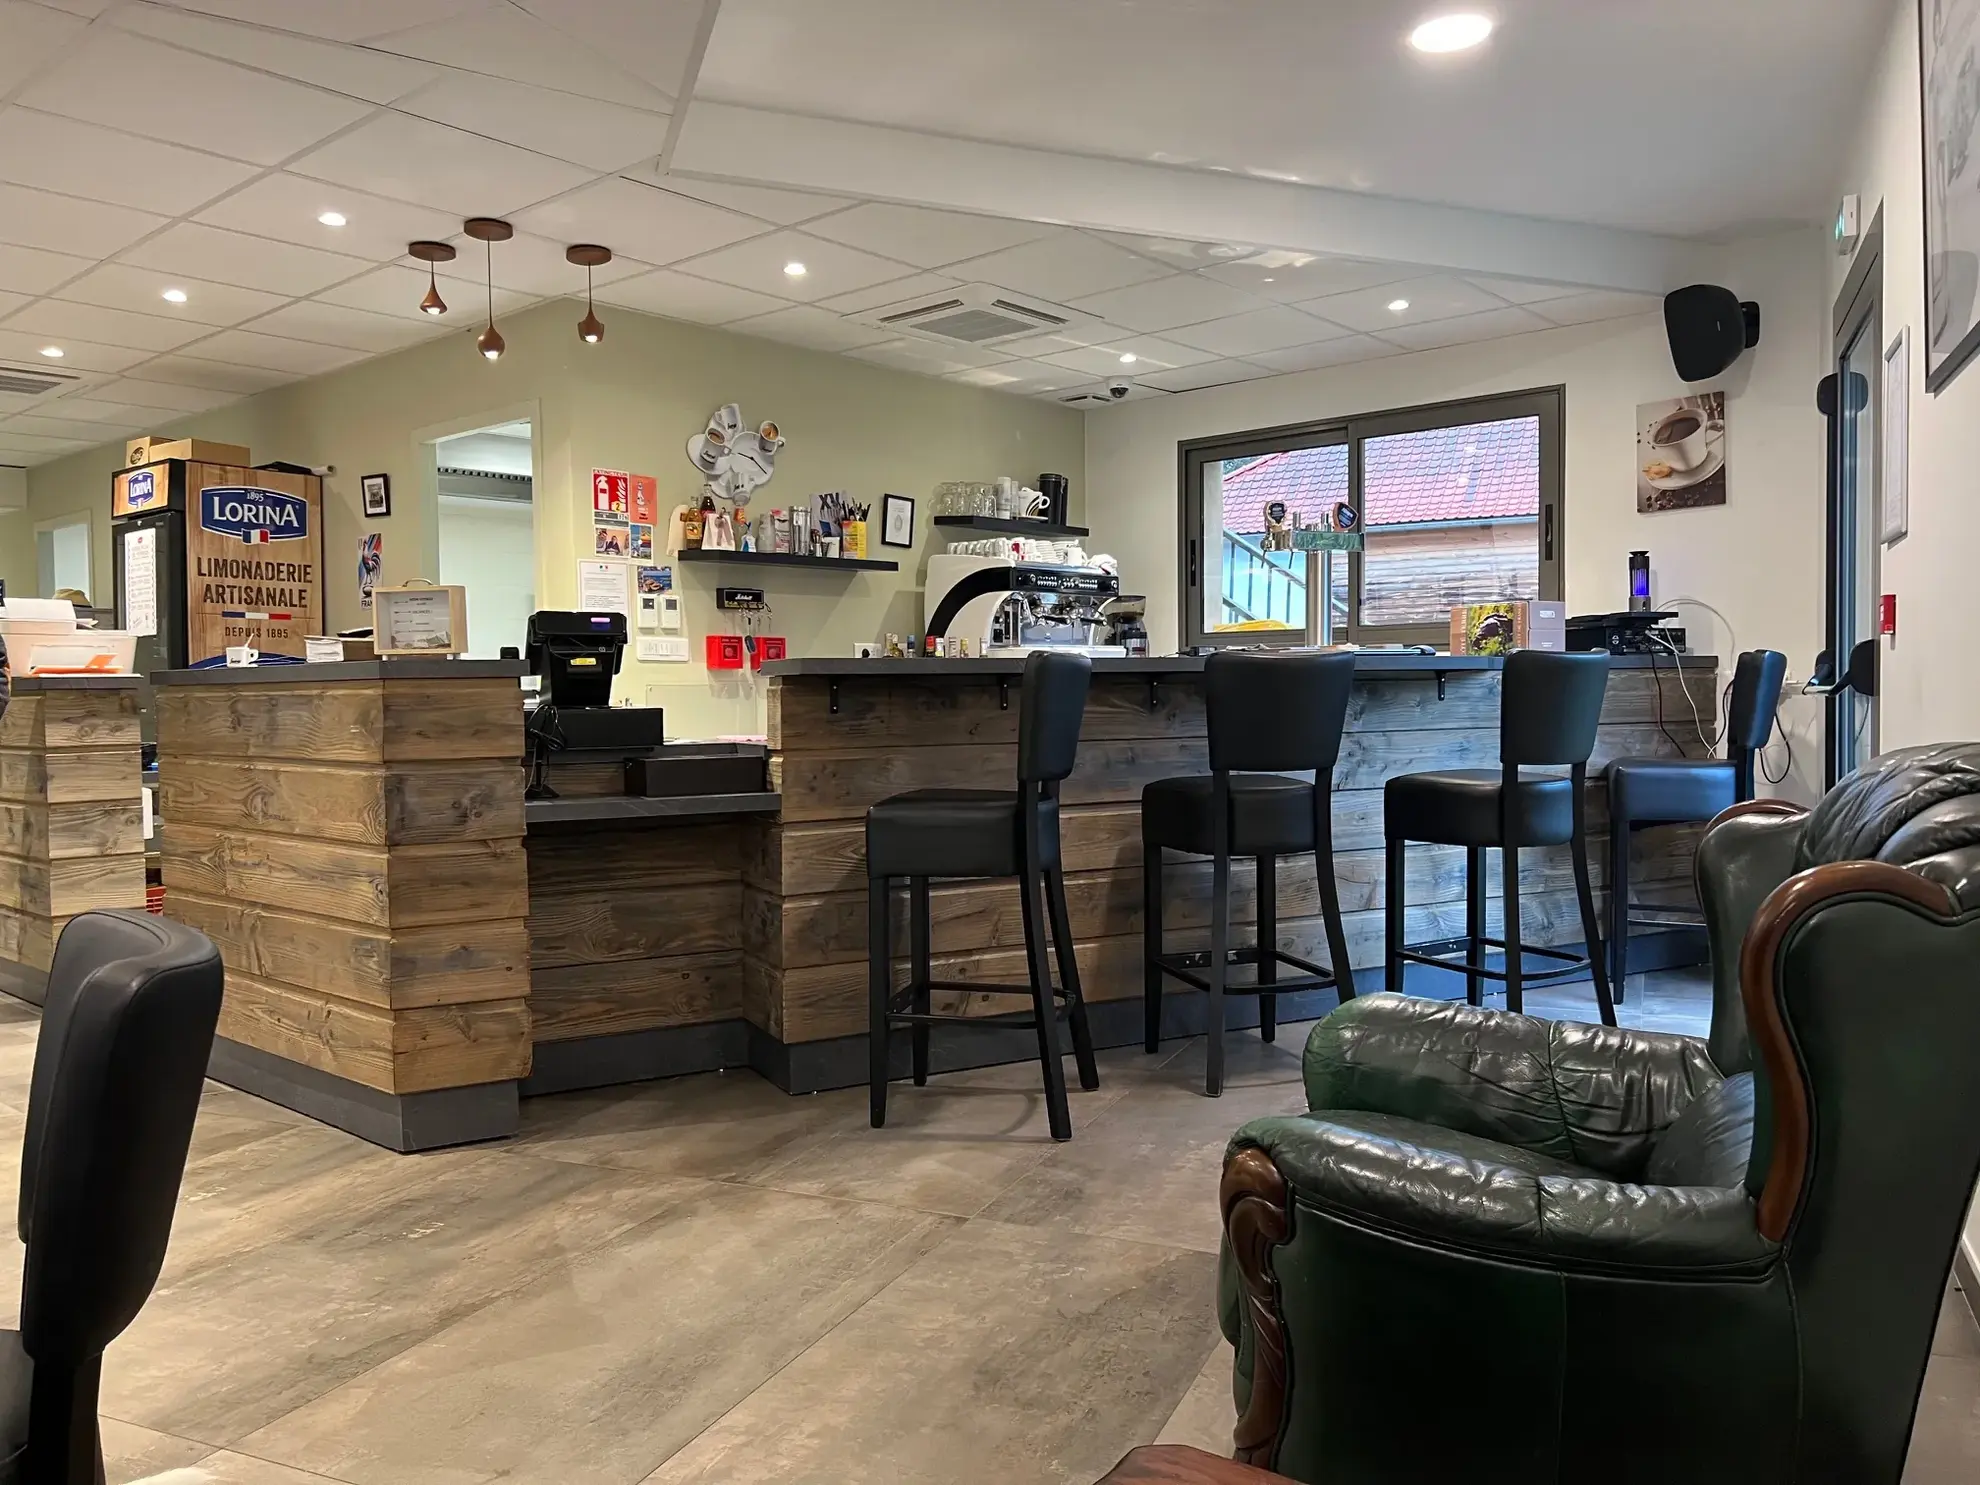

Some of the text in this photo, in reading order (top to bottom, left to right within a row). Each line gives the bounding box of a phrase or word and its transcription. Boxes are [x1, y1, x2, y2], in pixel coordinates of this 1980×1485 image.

[130, 478, 152, 498] LORINA
[246, 492, 264, 502] 1895
[213, 496, 299, 527] LORINA
[197, 557, 312, 583] LIMONADERIE
[203, 584, 307, 608] ARTISANALE
[225, 626, 288, 639] DEPUIS 1895
